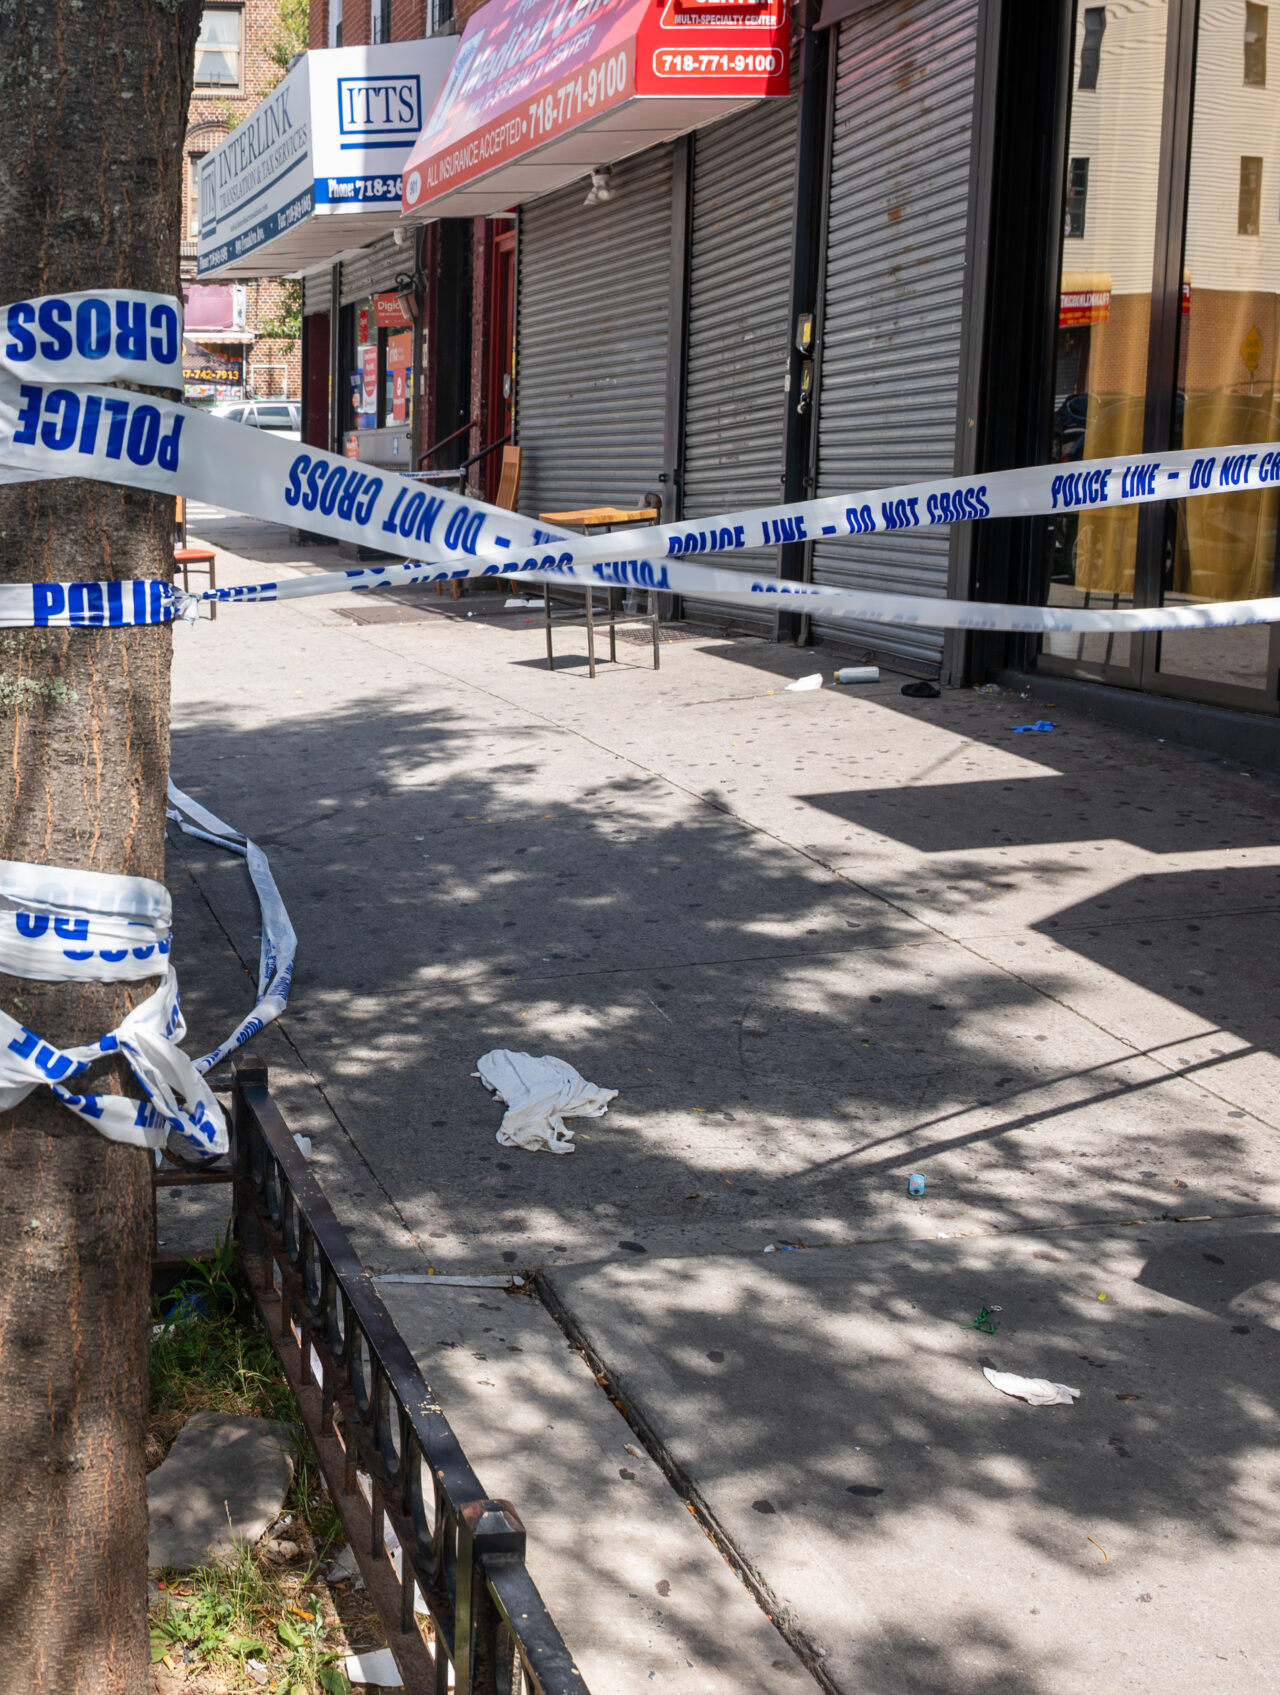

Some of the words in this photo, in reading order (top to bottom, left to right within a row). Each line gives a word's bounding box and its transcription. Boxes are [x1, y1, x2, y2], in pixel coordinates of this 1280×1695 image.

[675, 14, 743, 25] MULTI-SPECIALTY
[745, 15, 776, 26] CENTER
[662, 55, 775, 71] 718-771-9100
[347, 85, 415, 125] ITTS
[427, 167, 438, 188] ALL
[439, 142, 479, 182] INSURANCE
[478, 117, 521, 164] ACCEPTED
[529, 51, 627, 139] 718-771-9100
[219, 85, 293, 188] INTERLINK
[220, 166, 256, 211] TRANSLATION
[262, 156, 274, 180] TAX
[274, 122, 308, 171] SERVICES
[328, 178, 355, 198] Phone:
[5, 298, 178, 365] CROSS
[13, 385, 185, 473] POLICE
[284, 453, 384, 526] CROSS
[881, 497, 921, 531] NOT
[926, 485, 990, 525] CROSS
[1051, 468, 1113, 509] POLICE
[1121, 463, 1161, 499] LINE
[1189, 456, 1216, 490] DO
[1220, 453, 1258, 487] NOT
[381, 486, 444, 544] NOT
[444, 505, 488, 556] DO
[33, 579, 175, 627] POLI
